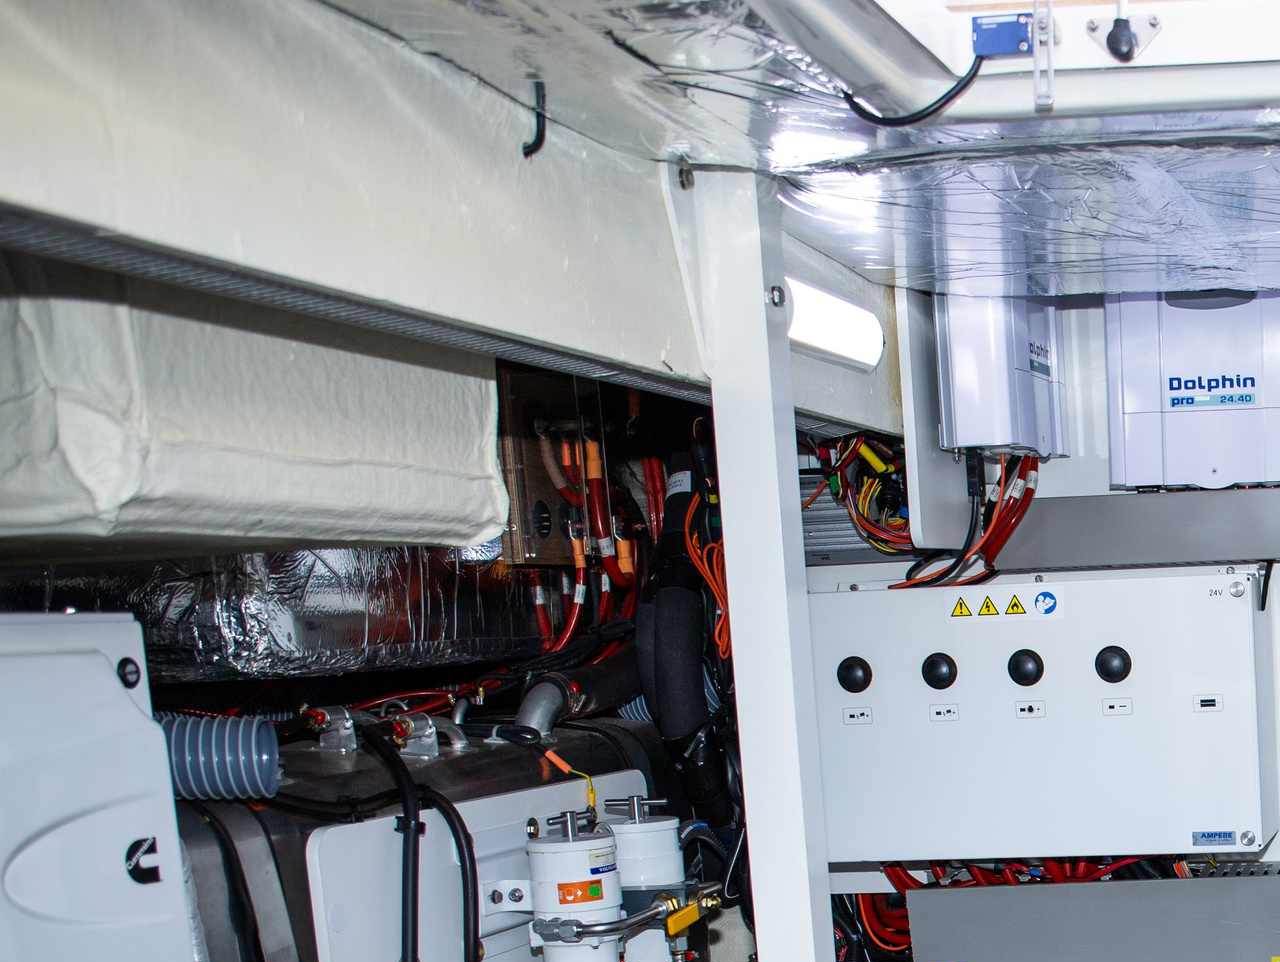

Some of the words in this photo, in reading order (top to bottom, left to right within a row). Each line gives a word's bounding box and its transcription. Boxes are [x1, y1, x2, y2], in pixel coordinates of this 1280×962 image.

[1169, 374, 1256, 392] Dolphin
[1220, 394, 1252, 404] 24.40
[126, 836, 154, 870] Cummins
